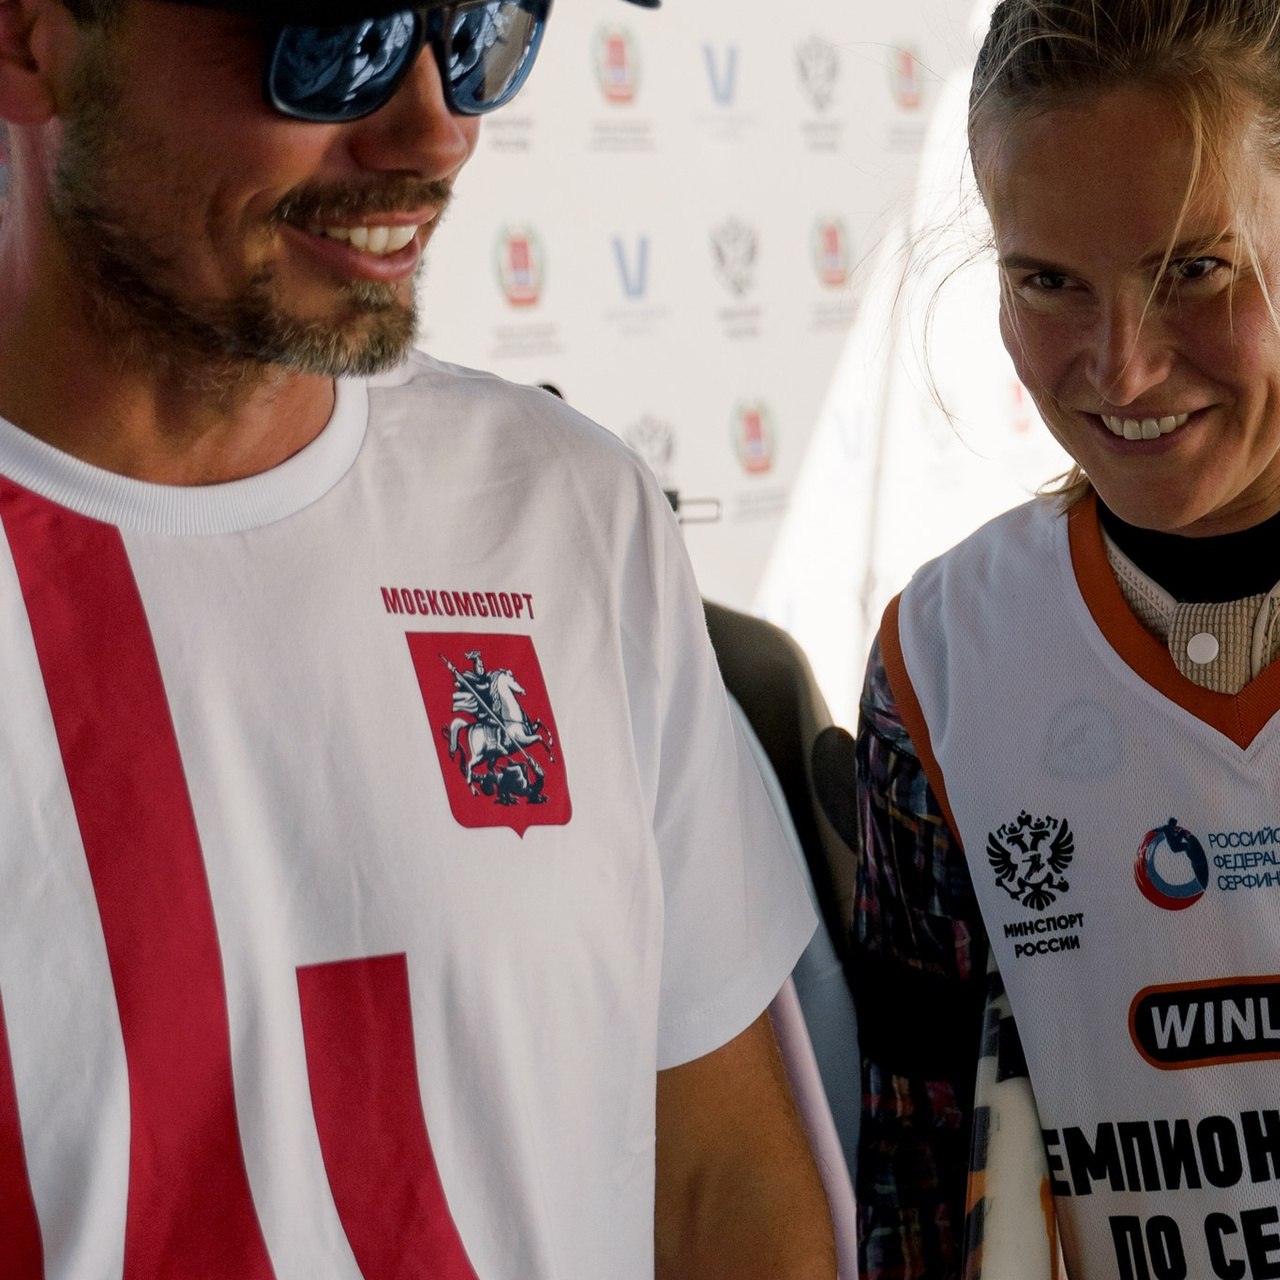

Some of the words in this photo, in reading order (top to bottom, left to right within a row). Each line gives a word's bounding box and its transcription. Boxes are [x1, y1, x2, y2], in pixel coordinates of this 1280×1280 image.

[380, 586, 535, 620] МОСКОМСПОРТ
[1003, 912, 1085, 938] МИНСПОРТ
[1014, 935, 1081, 958] РОССИИ
